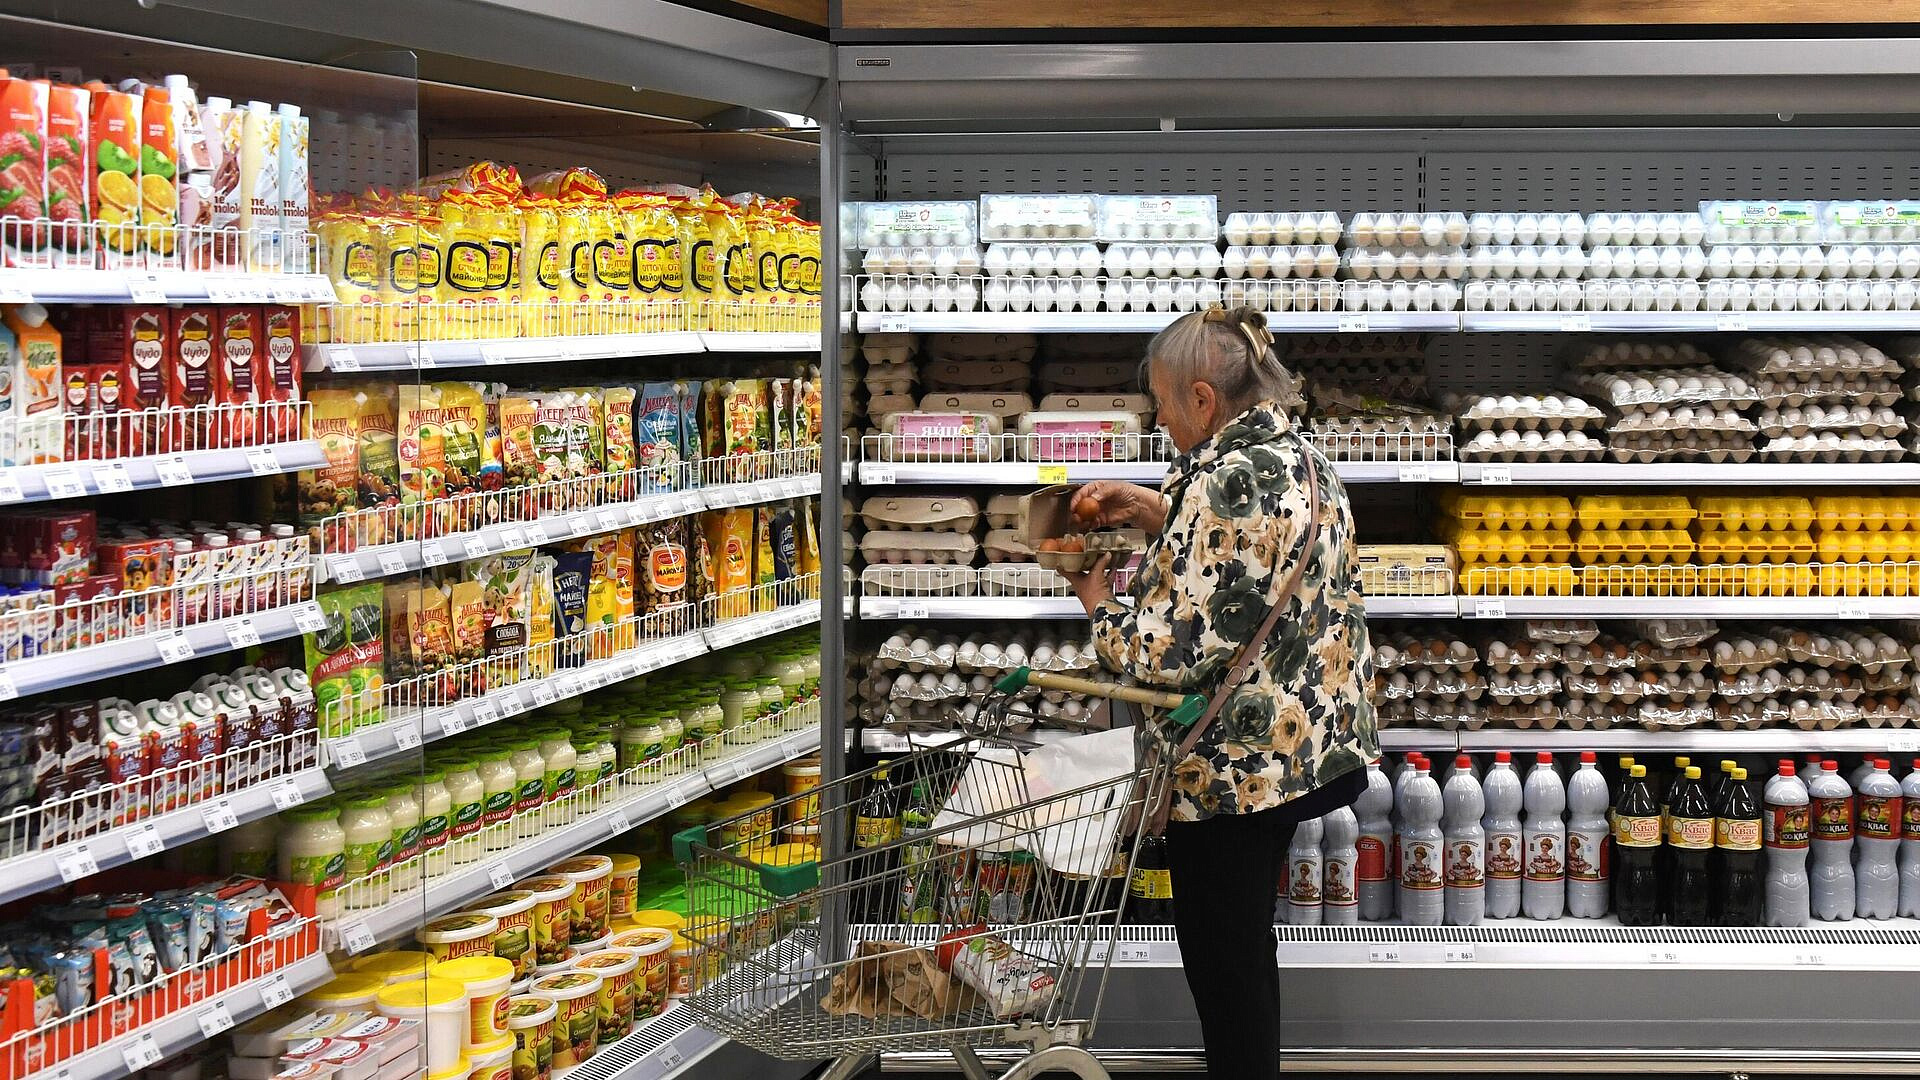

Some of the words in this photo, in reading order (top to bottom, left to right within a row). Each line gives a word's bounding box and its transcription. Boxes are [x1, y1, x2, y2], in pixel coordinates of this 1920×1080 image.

[251, 198, 265, 207] ne
[283, 200, 296, 208] ne
[214, 203, 240, 214] molok
[251, 206, 279, 217] molok
[283, 207, 308, 218] molok
[136, 347, 159, 361] Чудо
[184, 347, 208, 361] Чудо
[228, 345, 251, 358] Чудо
[272, 343, 292, 357] Чудо
[404, 408, 442, 436] МАХЕЕВ
[441, 406, 478, 431] АХЕЕВЪ
[656, 566, 685, 577] МАЙОНЗ
[320, 652, 352, 673] МАЙОНЕ
[1632, 822, 1657, 832] Квас
[1684, 823, 1710, 834] Квас
[1731, 825, 1757, 835] Квас
[1829, 824, 1849, 832] КВАС
[1868, 822, 1889, 831] КВАС
[496, 912, 532, 934] АХЕЕВЪ
